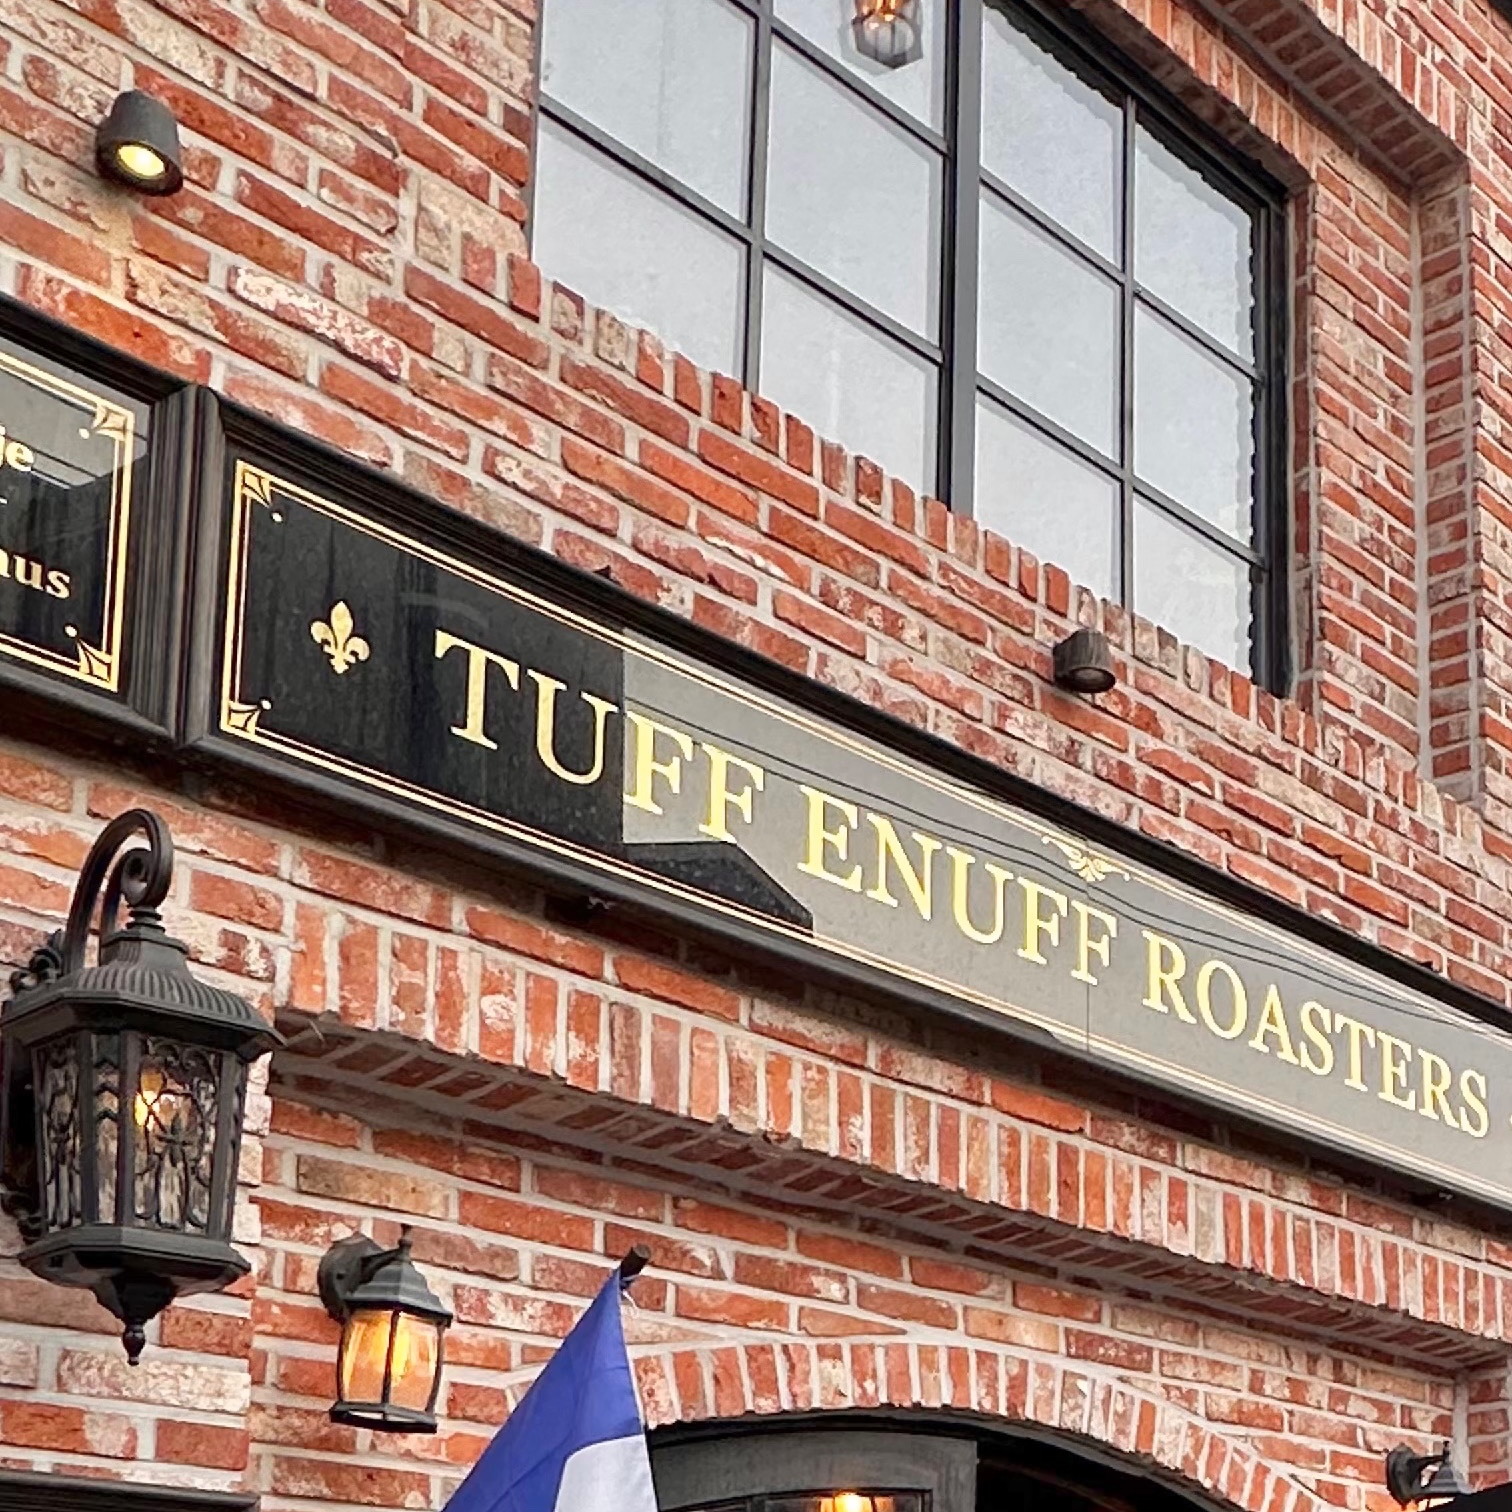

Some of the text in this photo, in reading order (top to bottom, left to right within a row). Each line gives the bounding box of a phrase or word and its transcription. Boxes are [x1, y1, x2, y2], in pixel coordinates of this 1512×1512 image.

[434, 629, 1490, 1138] TUFF ENUFF ROASTERS
